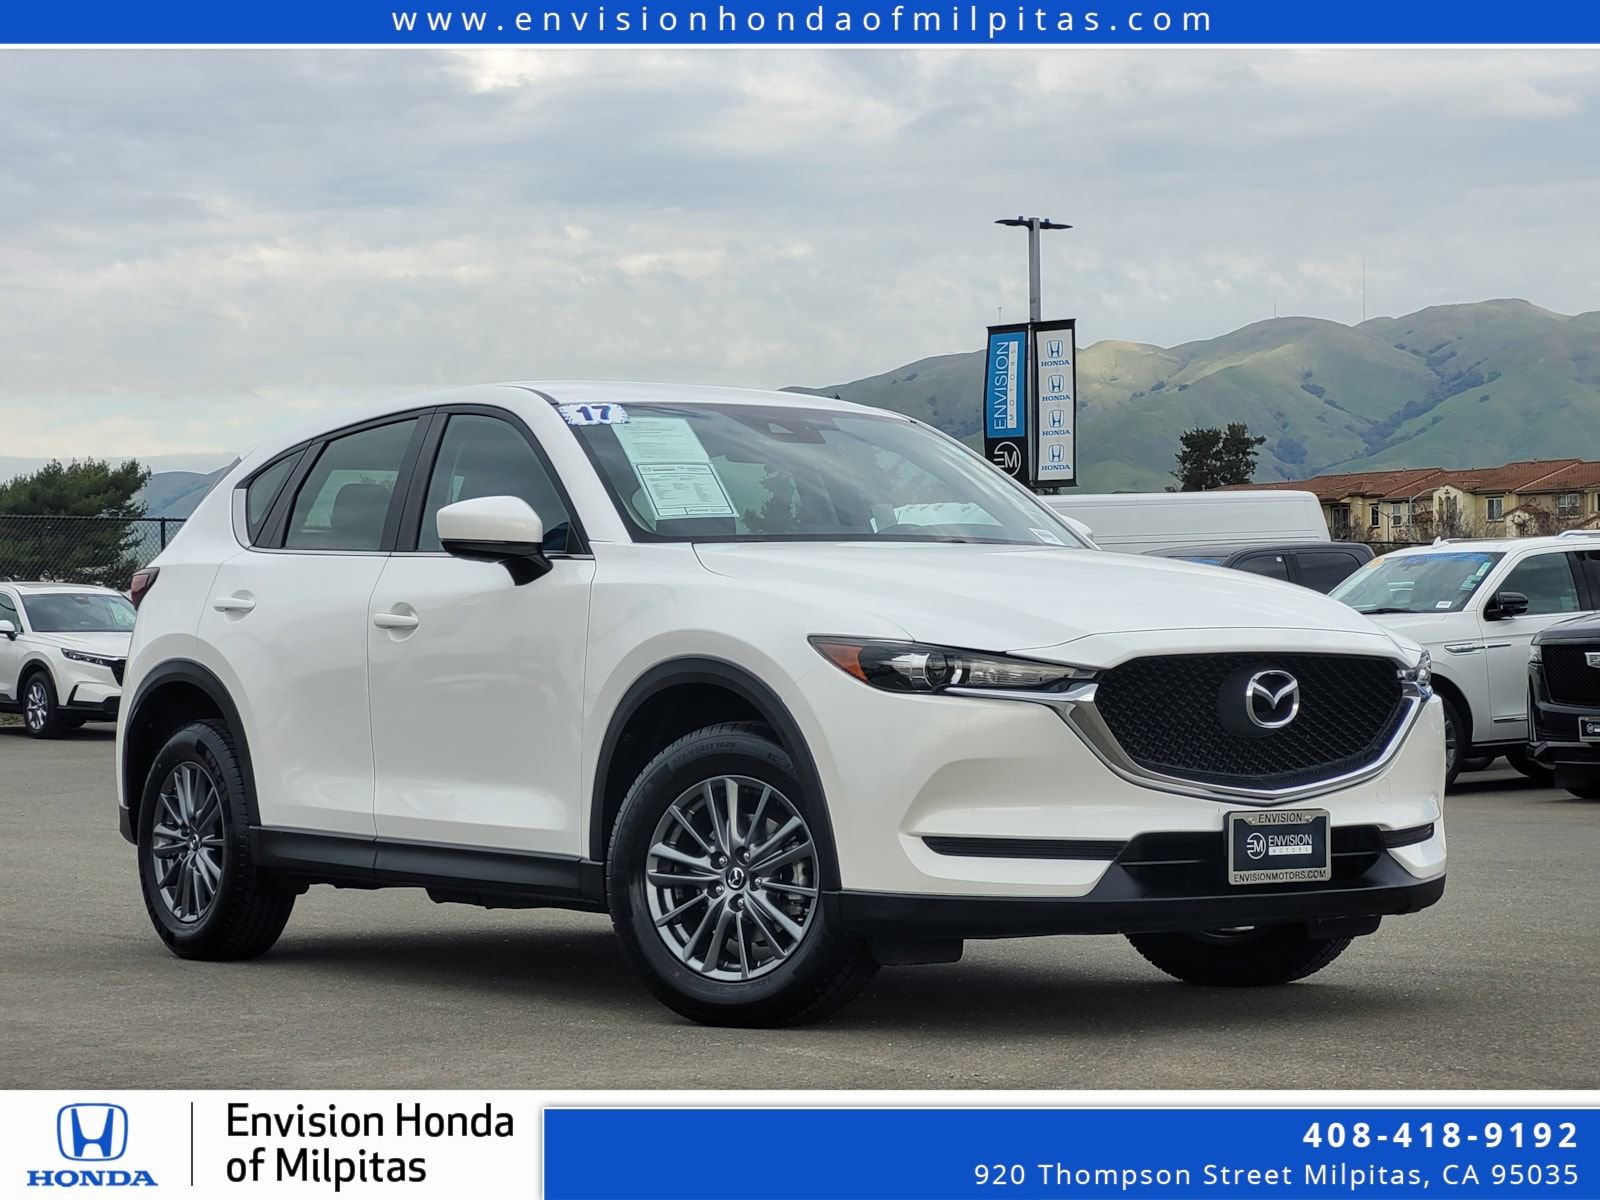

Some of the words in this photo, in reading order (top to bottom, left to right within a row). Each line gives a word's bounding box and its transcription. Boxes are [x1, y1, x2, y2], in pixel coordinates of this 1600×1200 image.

[1041, 359, 1070, 367] HONDA
[994, 341, 1009, 430] ENVISION
[1042, 394, 1071, 402] HONDA
[576, 405, 612, 422] 17
[1258, 813, 1303, 824] ENVISION
[1268, 834, 1313, 847] ENVISION
[1234, 870, 1327, 883] ENVISIONMOTORS.COM
